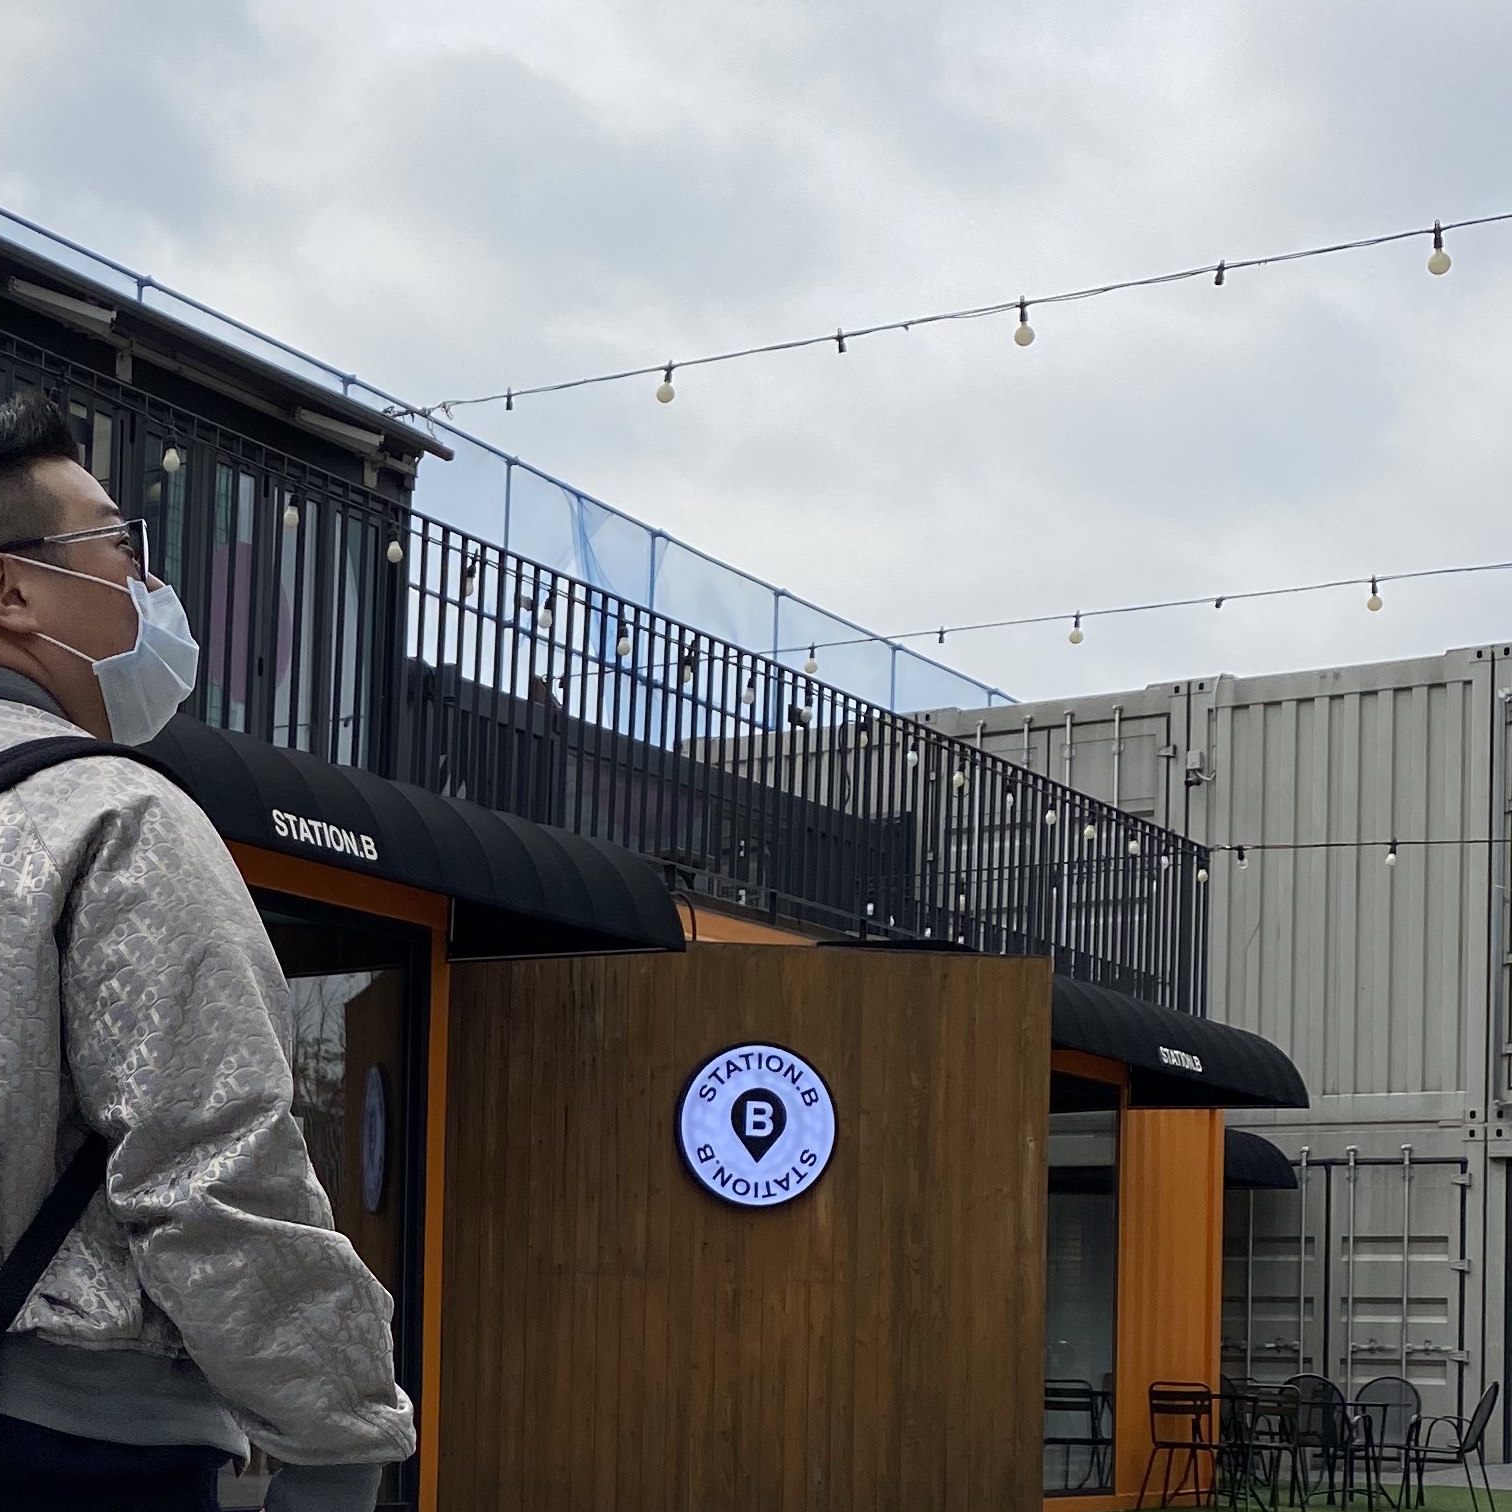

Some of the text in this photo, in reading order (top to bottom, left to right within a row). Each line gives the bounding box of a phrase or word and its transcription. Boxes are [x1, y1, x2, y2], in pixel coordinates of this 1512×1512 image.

[272, 808, 378, 861] STATION.B
[699, 1052, 819, 1107] STATION.B
[745, 1100, 774, 1137] B
[697, 1143, 818, 1199] STATION.B
